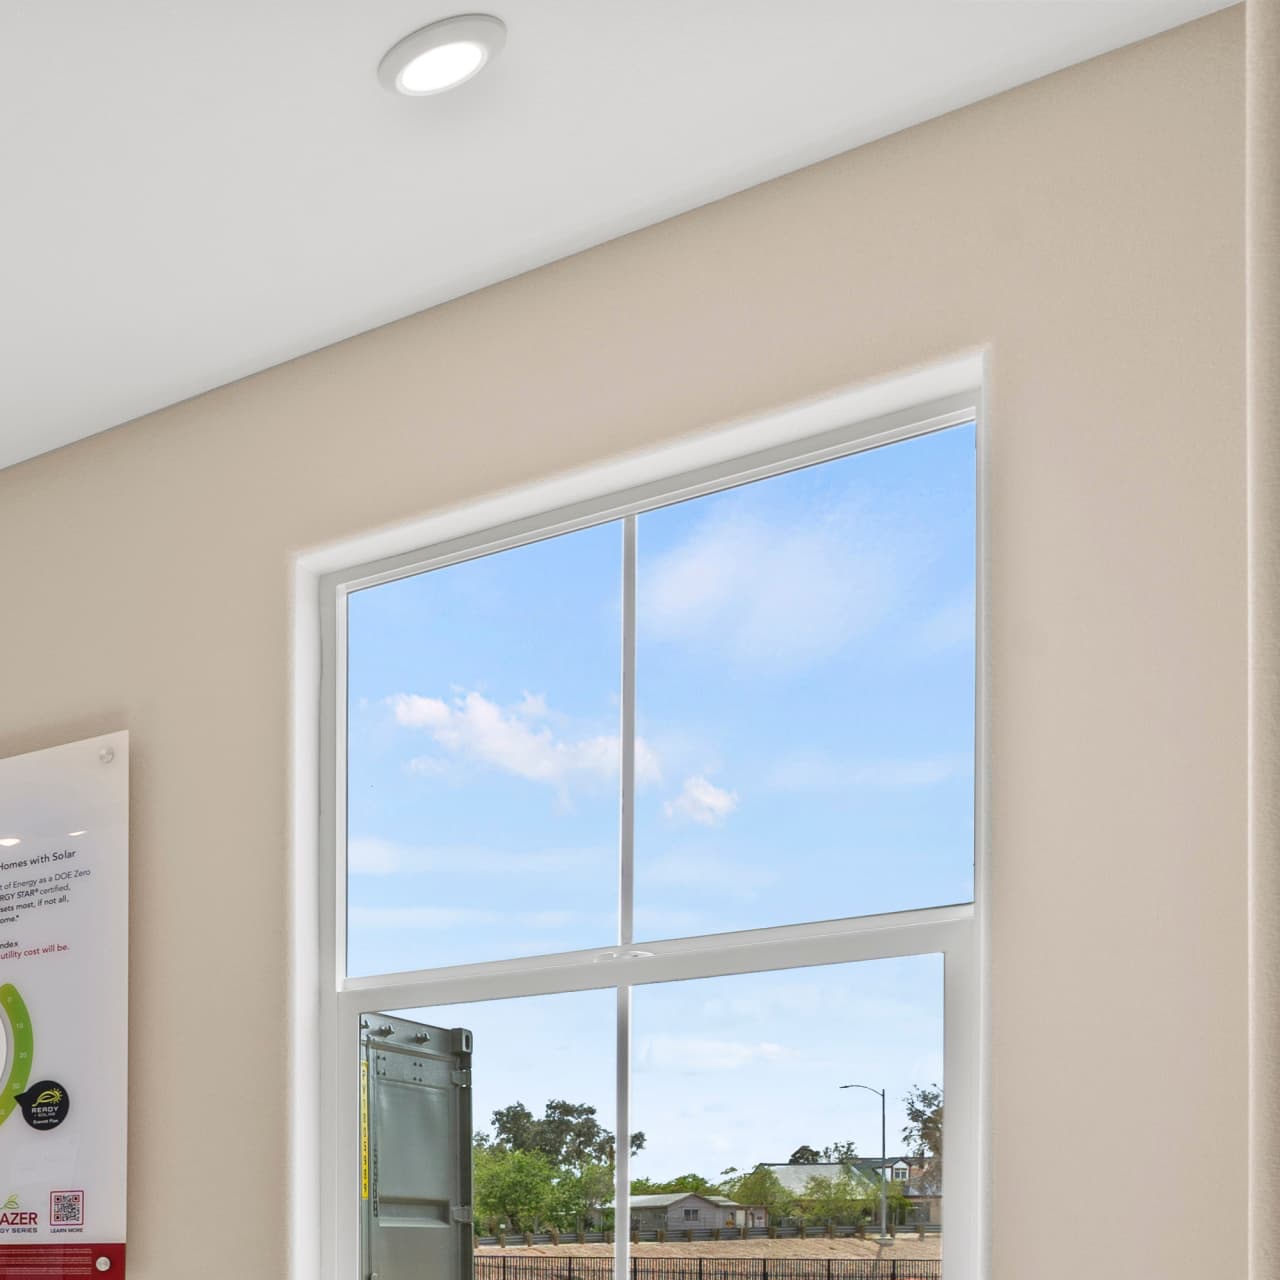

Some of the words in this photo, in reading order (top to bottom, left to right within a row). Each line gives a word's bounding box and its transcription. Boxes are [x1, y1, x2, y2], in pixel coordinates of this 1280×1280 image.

[30, 854, 50, 865] with
[52, 850, 76, 861] Solar
[13, 879, 37, 888] Energy
[54, 871, 73, 881] DOE
[73, 869, 91, 878] Zero
[44, 897, 56, 905] not
[0, 950, 23, 960] utility
[23, 947, 40, 957] cost
[42, 944, 55, 954] will
